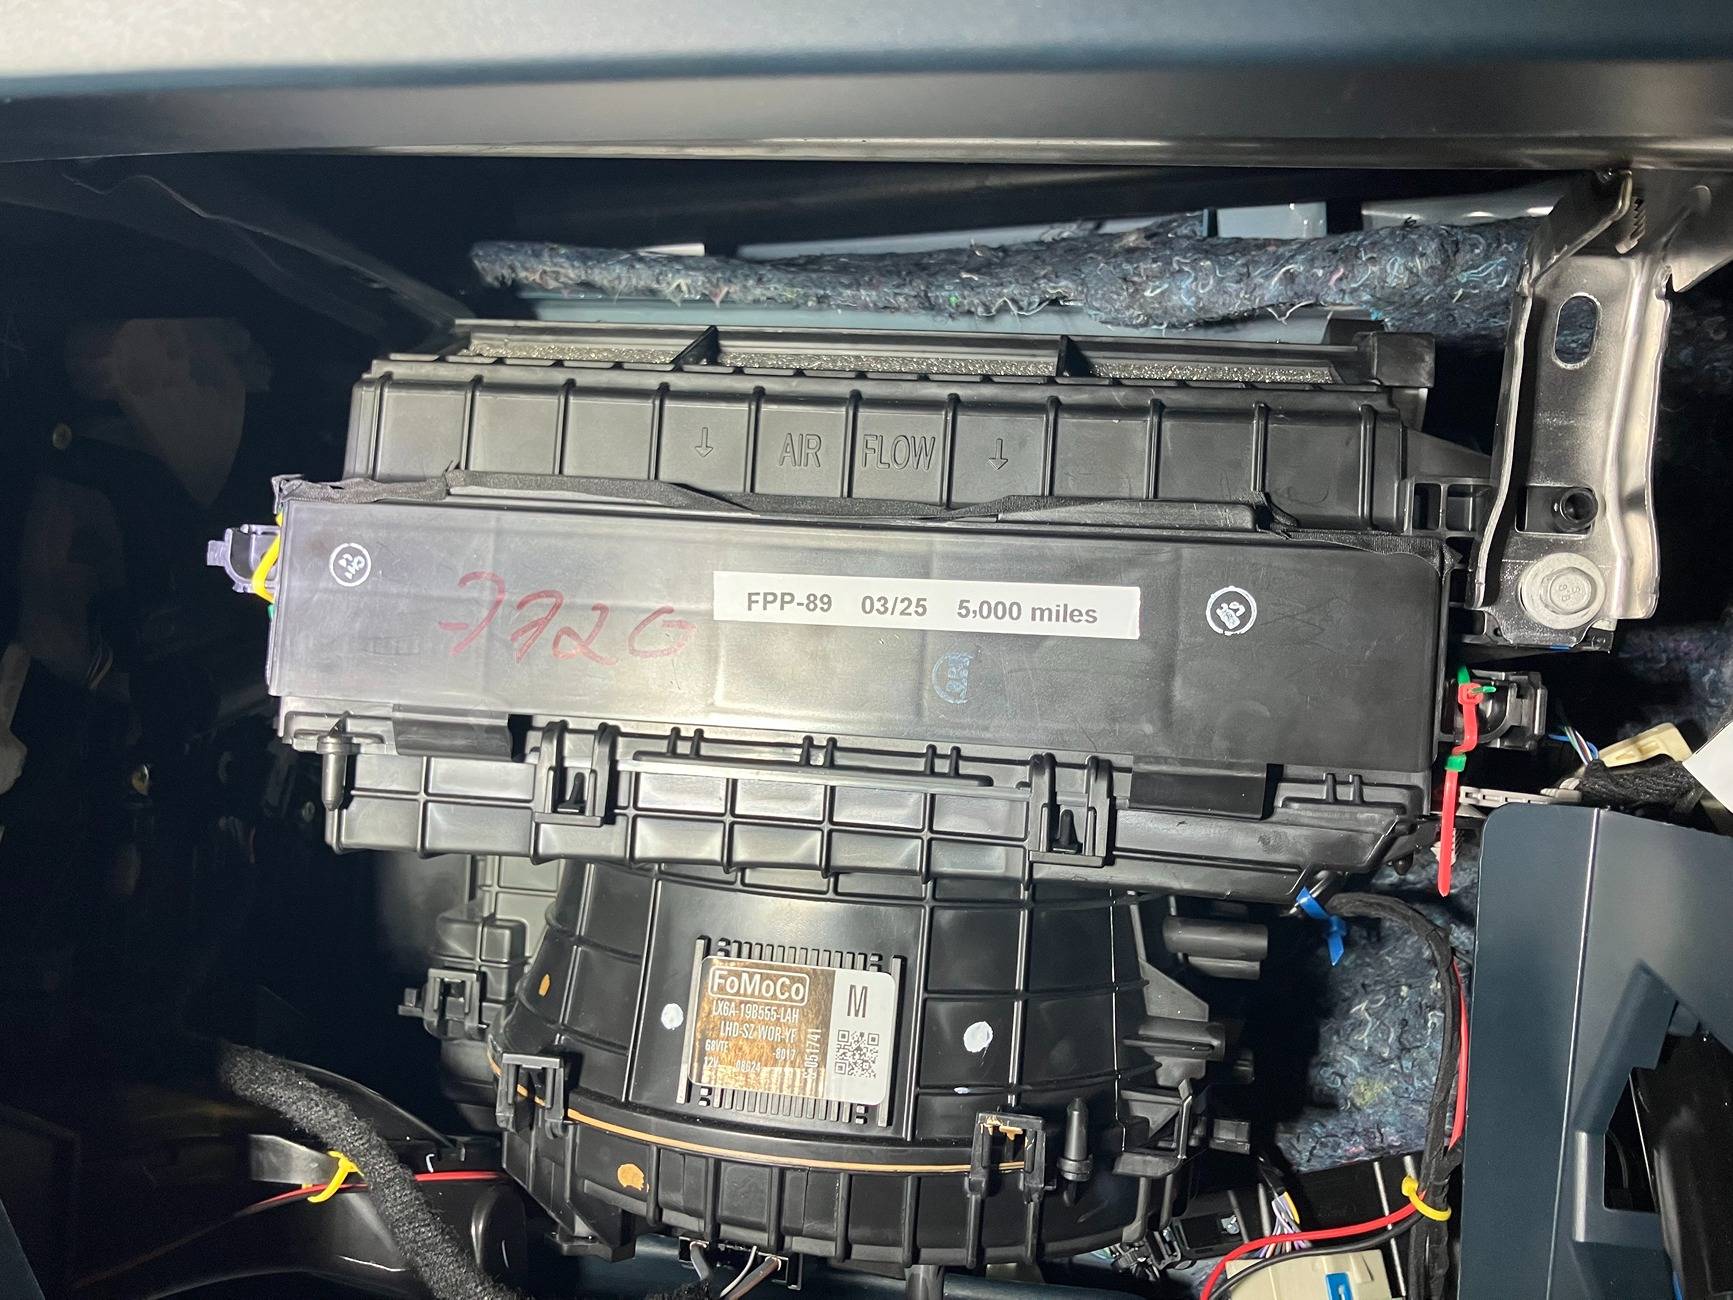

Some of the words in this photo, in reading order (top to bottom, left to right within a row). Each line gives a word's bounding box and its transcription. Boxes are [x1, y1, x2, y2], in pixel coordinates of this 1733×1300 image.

[778, 432, 822, 469] AIR
[861, 433, 936, 472] FLOW
[747, 592, 833, 613] FPP-89
[861, 595, 928, 617] 03/25
[956, 599, 1022, 621] 5,000
[1030, 603, 1098, 624] miles
[712, 969, 806, 1001] FoMoCo
[847, 983, 869, 1019] M
